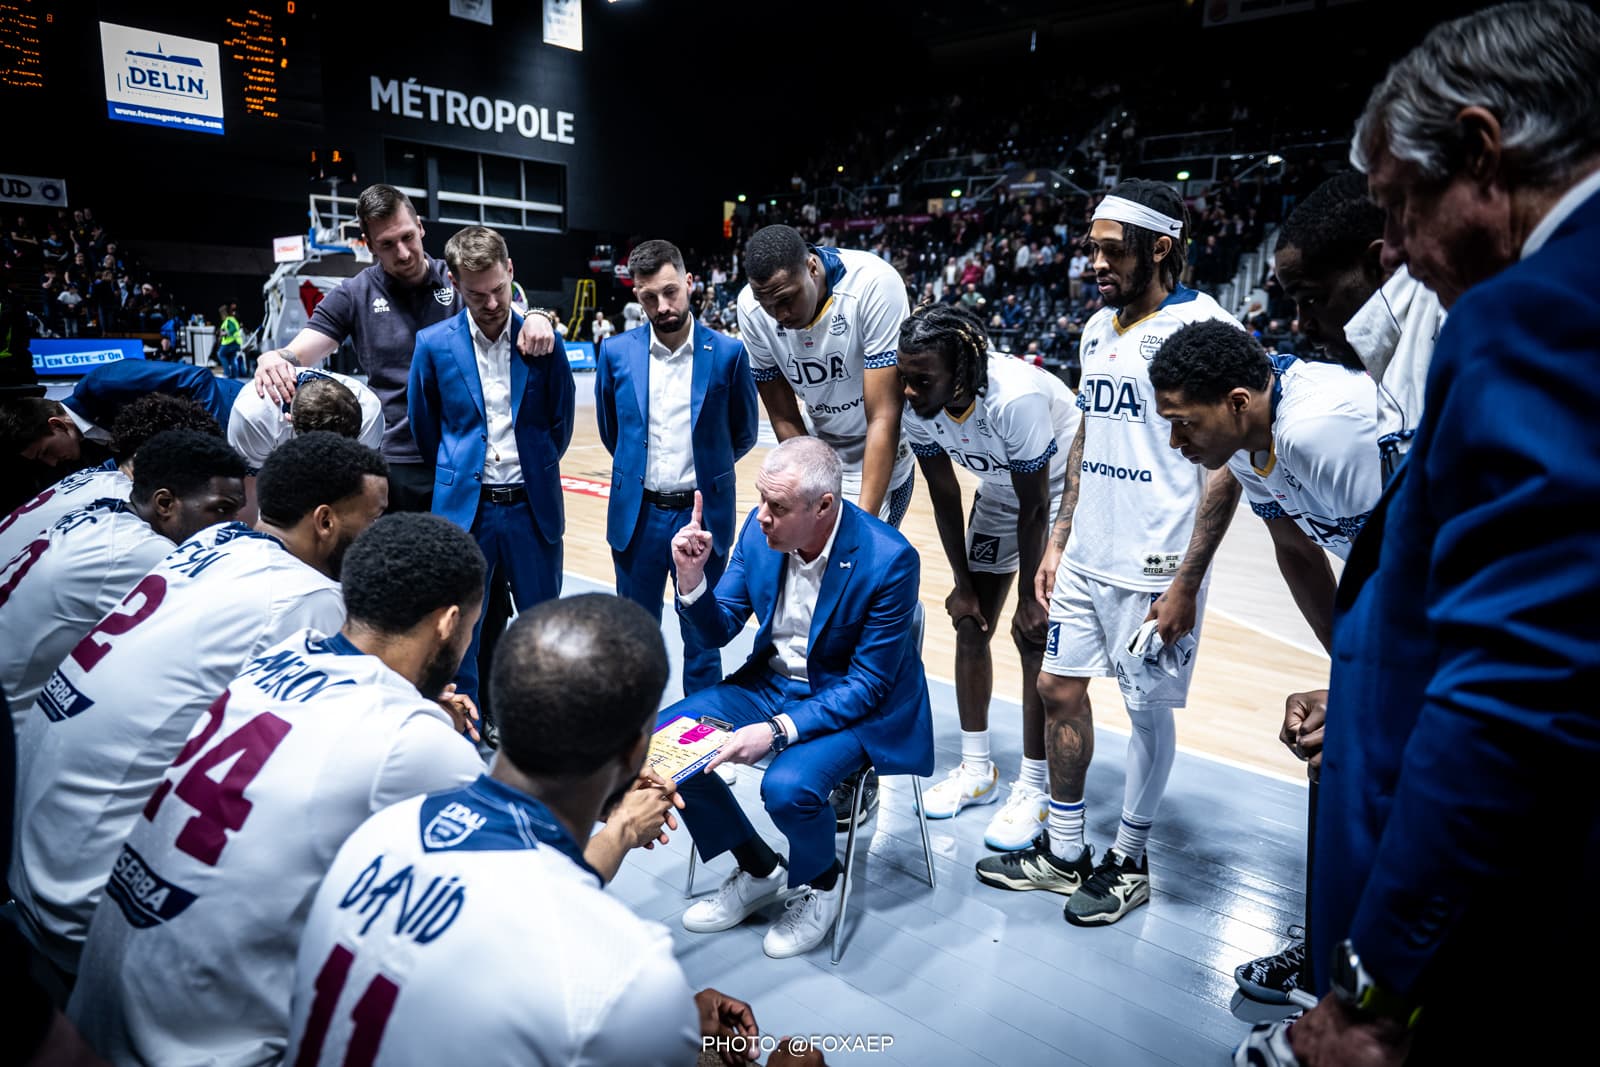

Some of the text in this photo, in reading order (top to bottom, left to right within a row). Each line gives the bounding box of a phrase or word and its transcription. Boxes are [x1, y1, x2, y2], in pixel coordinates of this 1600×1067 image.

[128, 66, 204, 95] DELIN
[370, 75, 575, 144] MÉTROPOLE
[788, 354, 848, 387] JDA
[114, 852, 171, 912] SERBA
[292, 943, 400, 1067] 11
